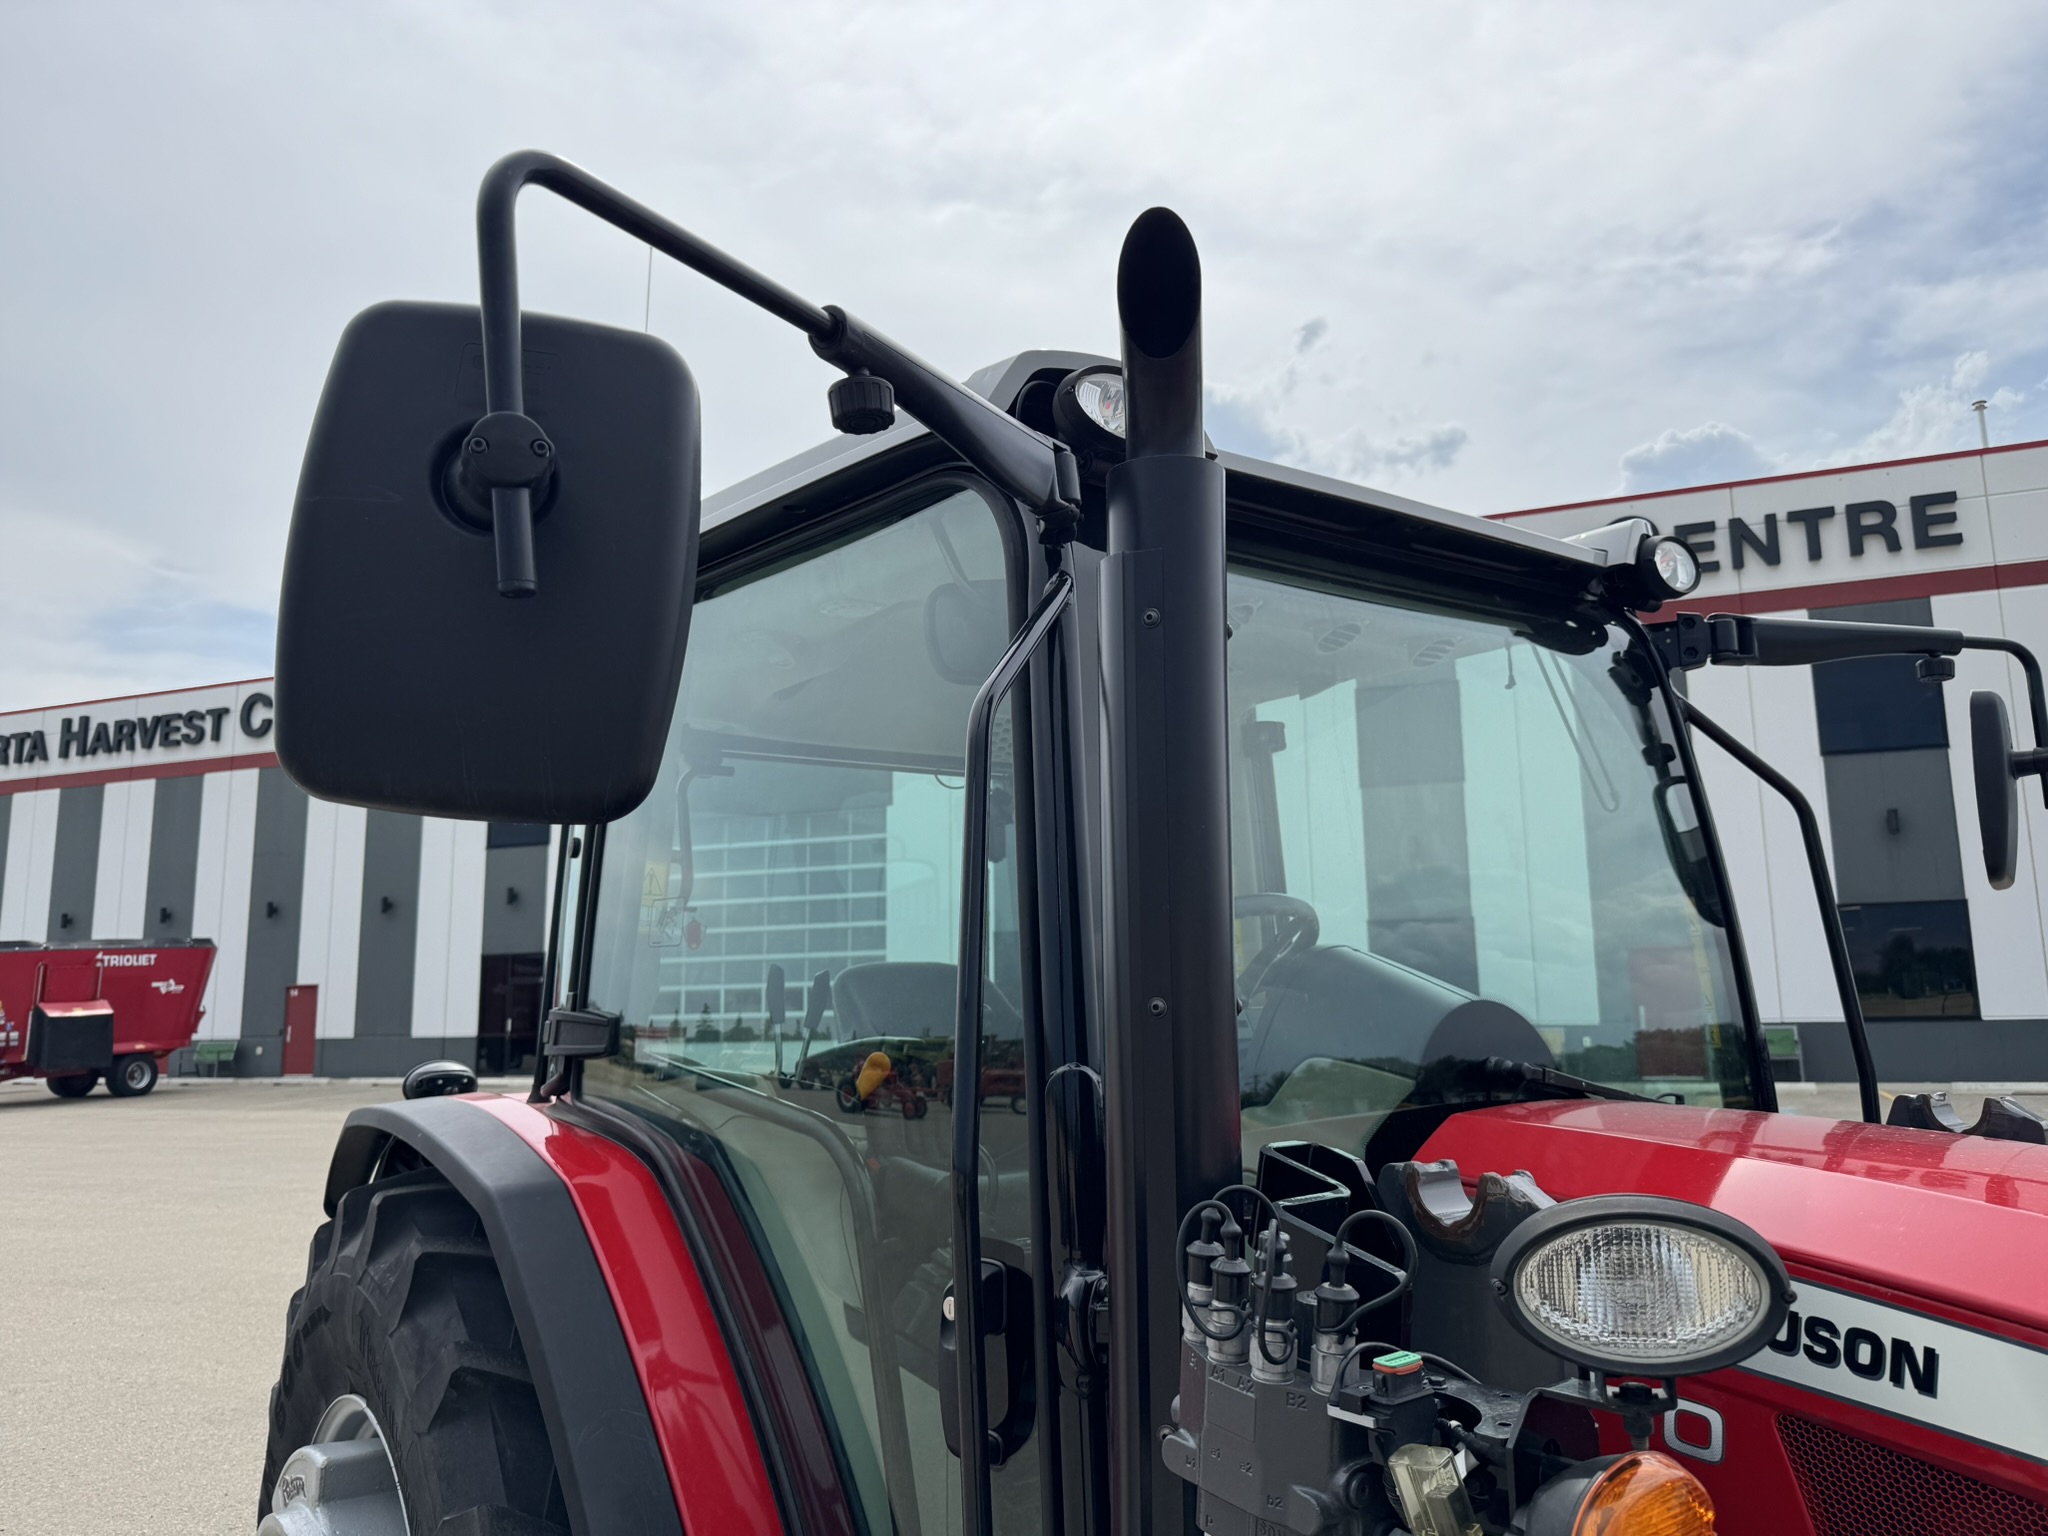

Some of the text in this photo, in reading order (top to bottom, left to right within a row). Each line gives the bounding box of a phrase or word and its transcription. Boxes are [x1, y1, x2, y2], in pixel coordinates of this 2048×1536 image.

[1607, 490, 1963, 573] ENTRE
[58, 707, 230, 759] HARVEST
[102, 953, 158, 967] TRIOLIET
[1286, 1392, 1308, 1410] B2
[1267, 1495, 1284, 1510] b2
